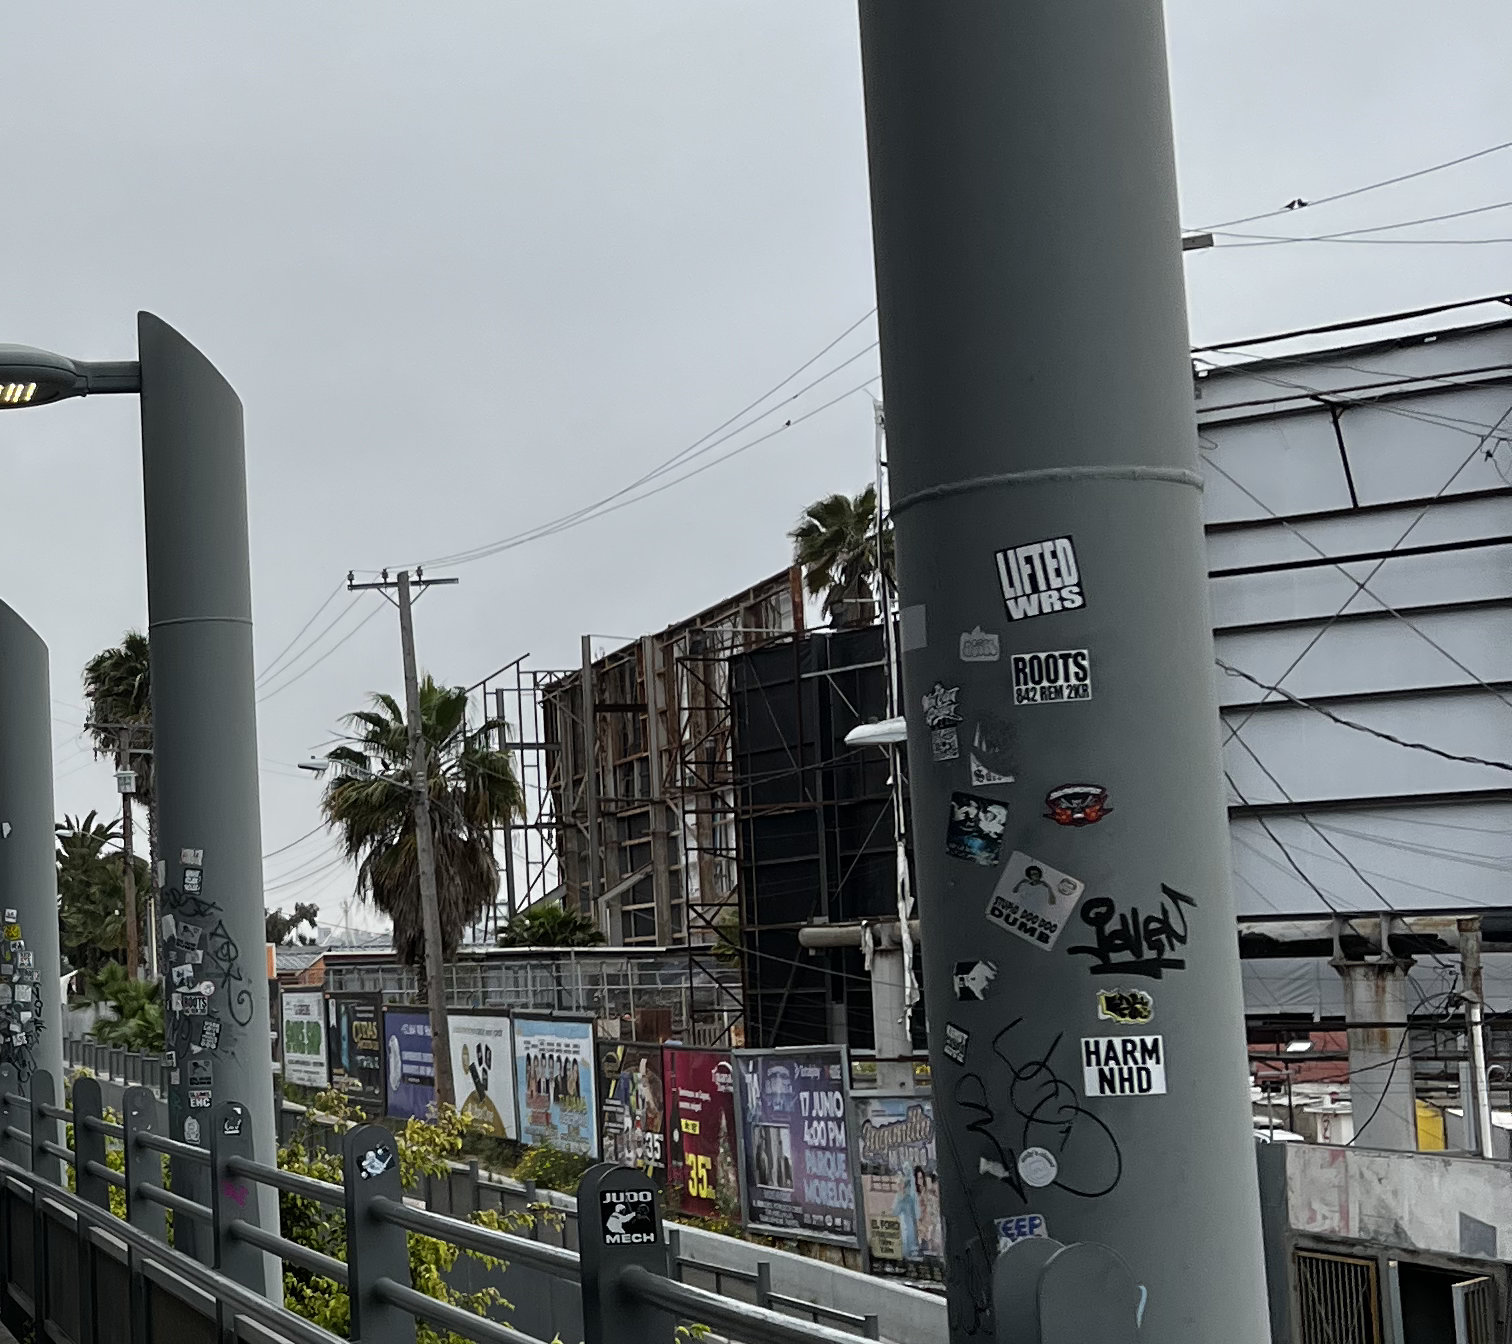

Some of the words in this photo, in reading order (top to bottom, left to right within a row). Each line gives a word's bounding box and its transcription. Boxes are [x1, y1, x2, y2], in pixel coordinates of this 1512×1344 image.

[995, 537, 1079, 599] LIFTED
[1005, 585, 1084, 621] WRS
[1013, 651, 1088, 687] ROOTS
[990, 906, 1052, 945] DUMB
[1084, 1037, 1161, 1068] HARM
[1098, 1065, 1152, 1095] NHD
[812, 1091, 844, 1118] JUNIO
[827, 1120, 847, 1149] PM
[602, 1191, 653, 1204] JUDO
[605, 1232, 655, 1244] MECH
